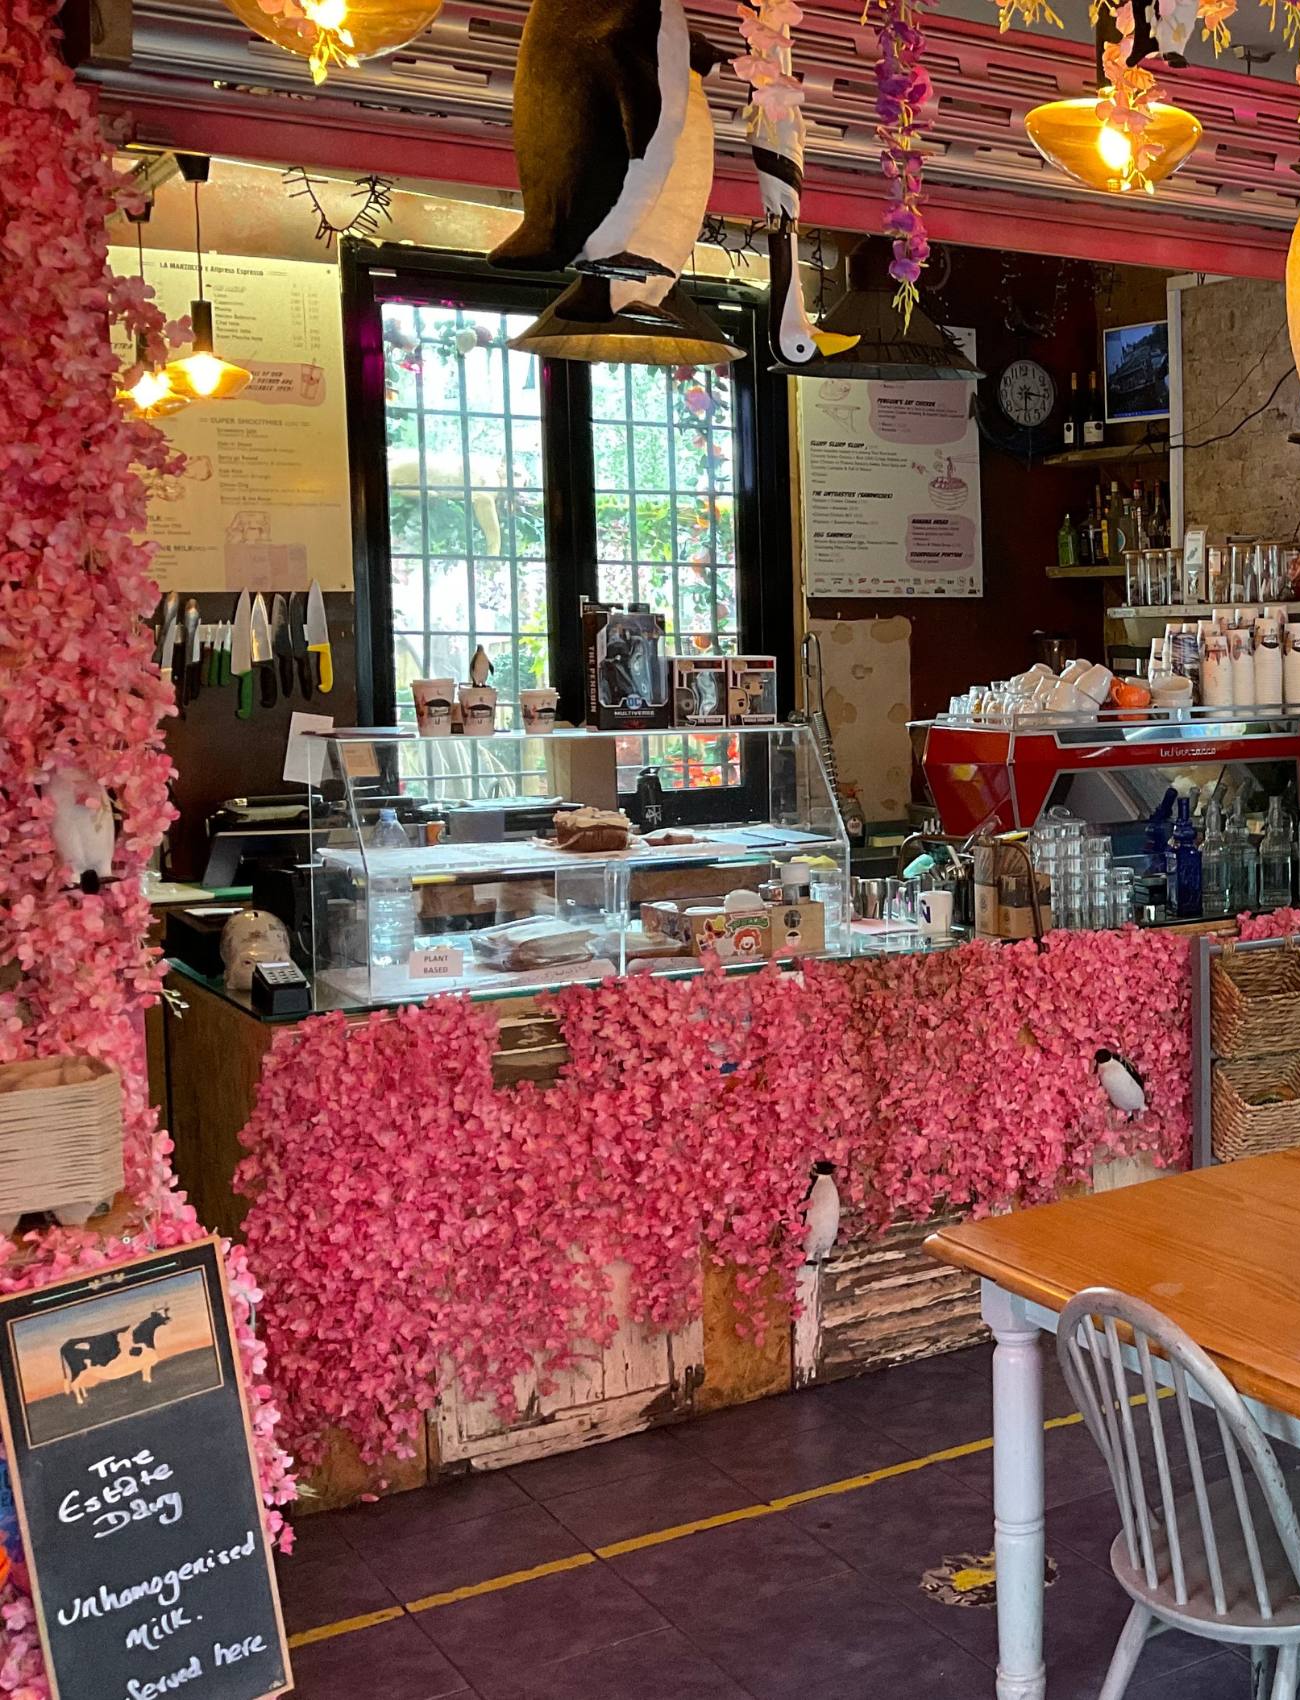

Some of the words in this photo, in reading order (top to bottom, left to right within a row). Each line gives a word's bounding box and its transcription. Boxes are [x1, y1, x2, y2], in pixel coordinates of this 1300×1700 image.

[424, 966, 448, 974] BASED
[88, 1449, 155, 1479] The
[58, 1461, 175, 1525] Estate
[213, 1631, 268, 1668] here
